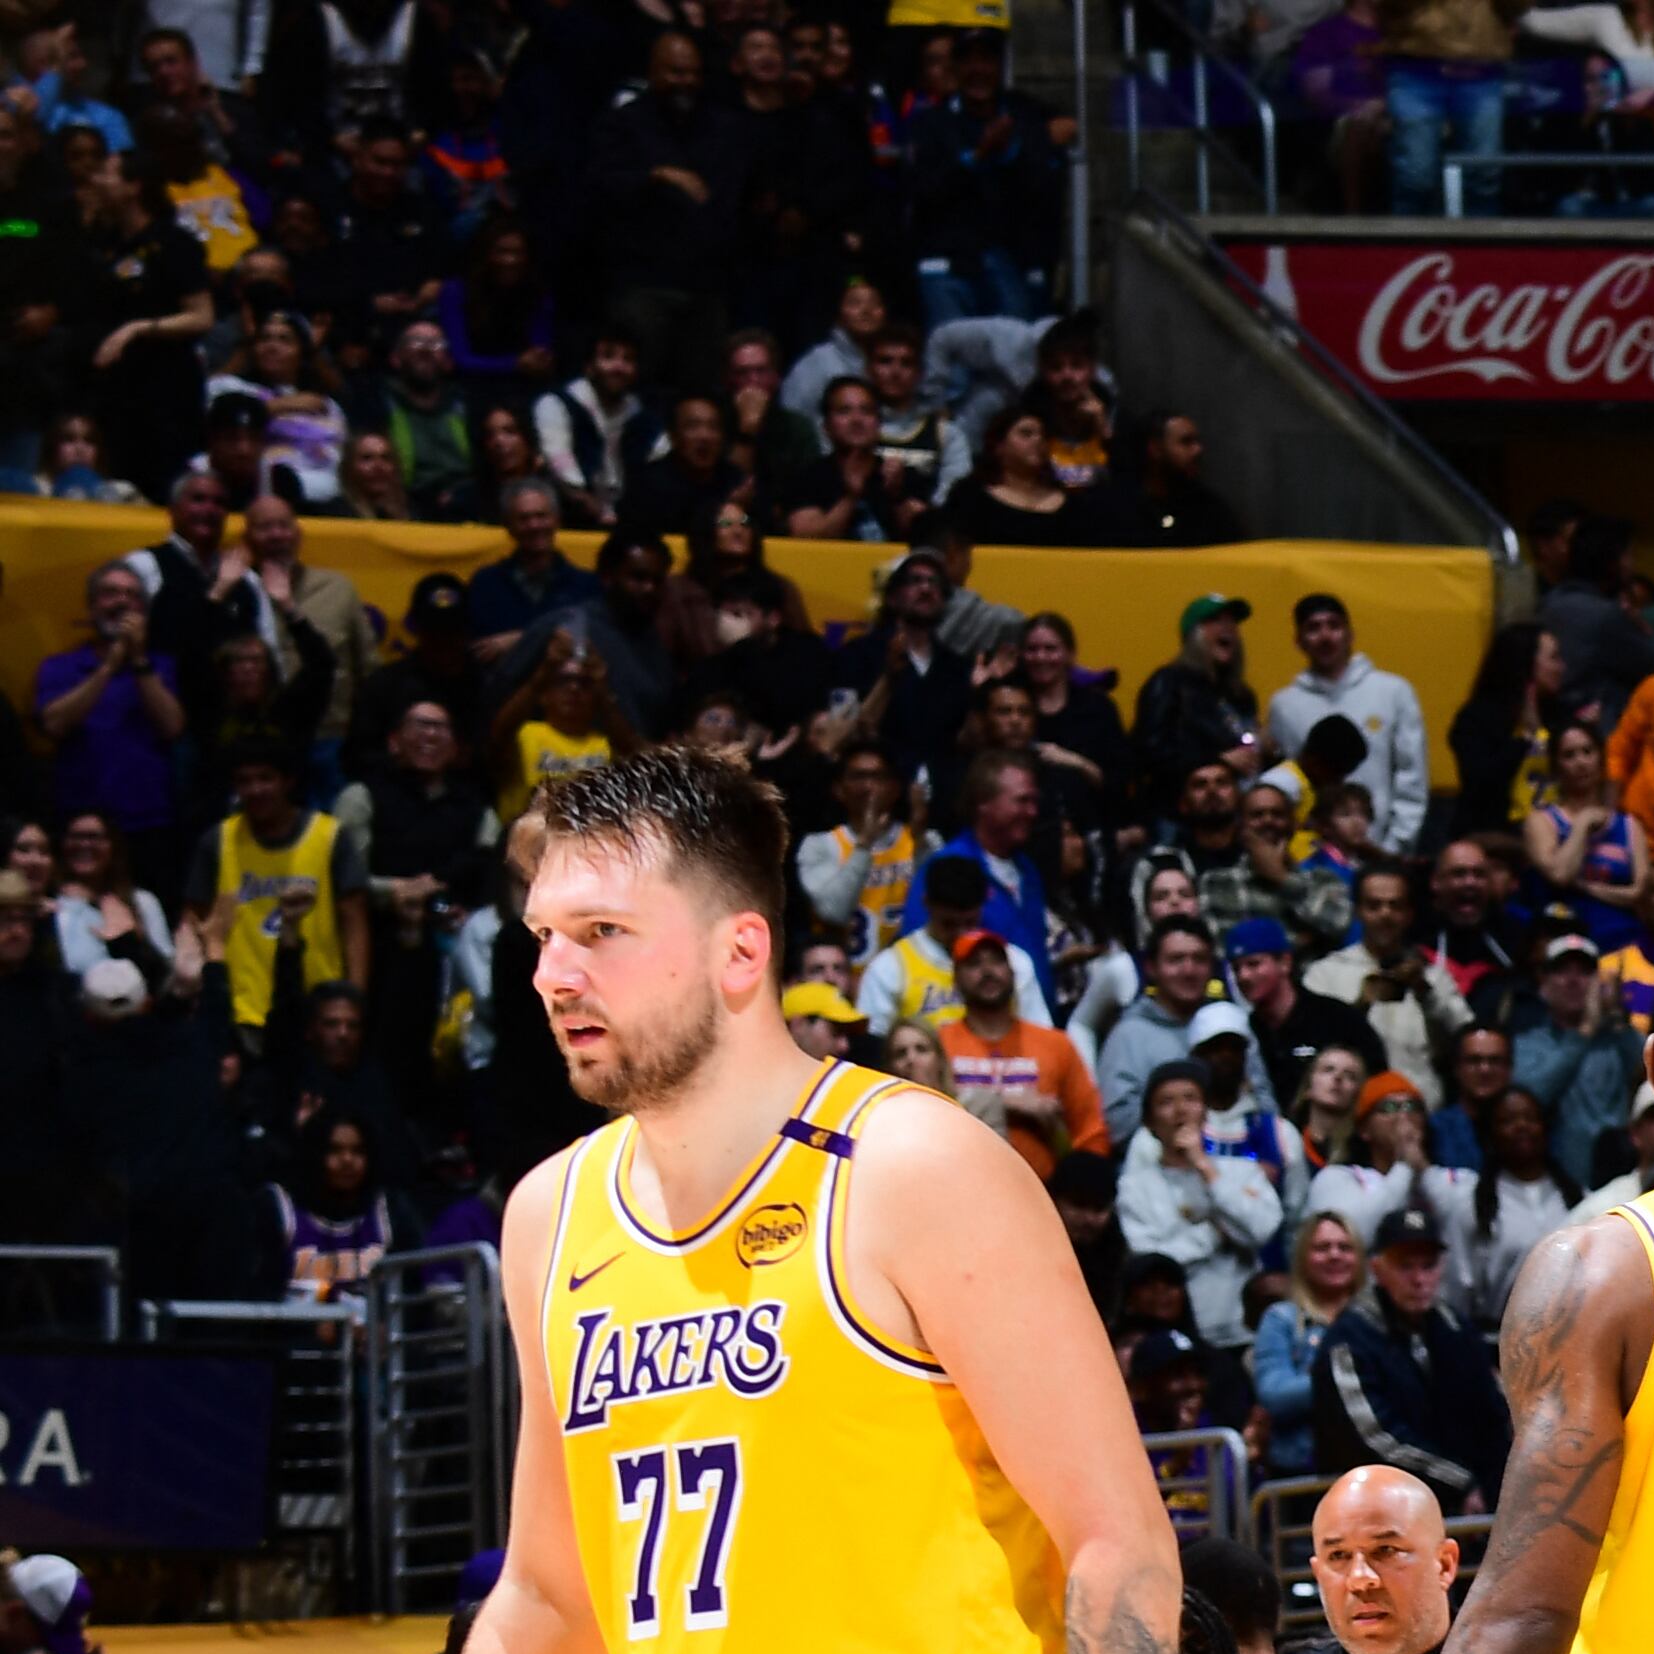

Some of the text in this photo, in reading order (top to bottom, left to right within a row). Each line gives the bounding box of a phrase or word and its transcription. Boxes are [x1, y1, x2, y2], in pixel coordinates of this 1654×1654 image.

[742, 1220, 803, 1246] bibigo
[563, 1301, 788, 1432] LAKERS
[0, 1406, 84, 1488] A
[613, 1438, 743, 1642] 77
